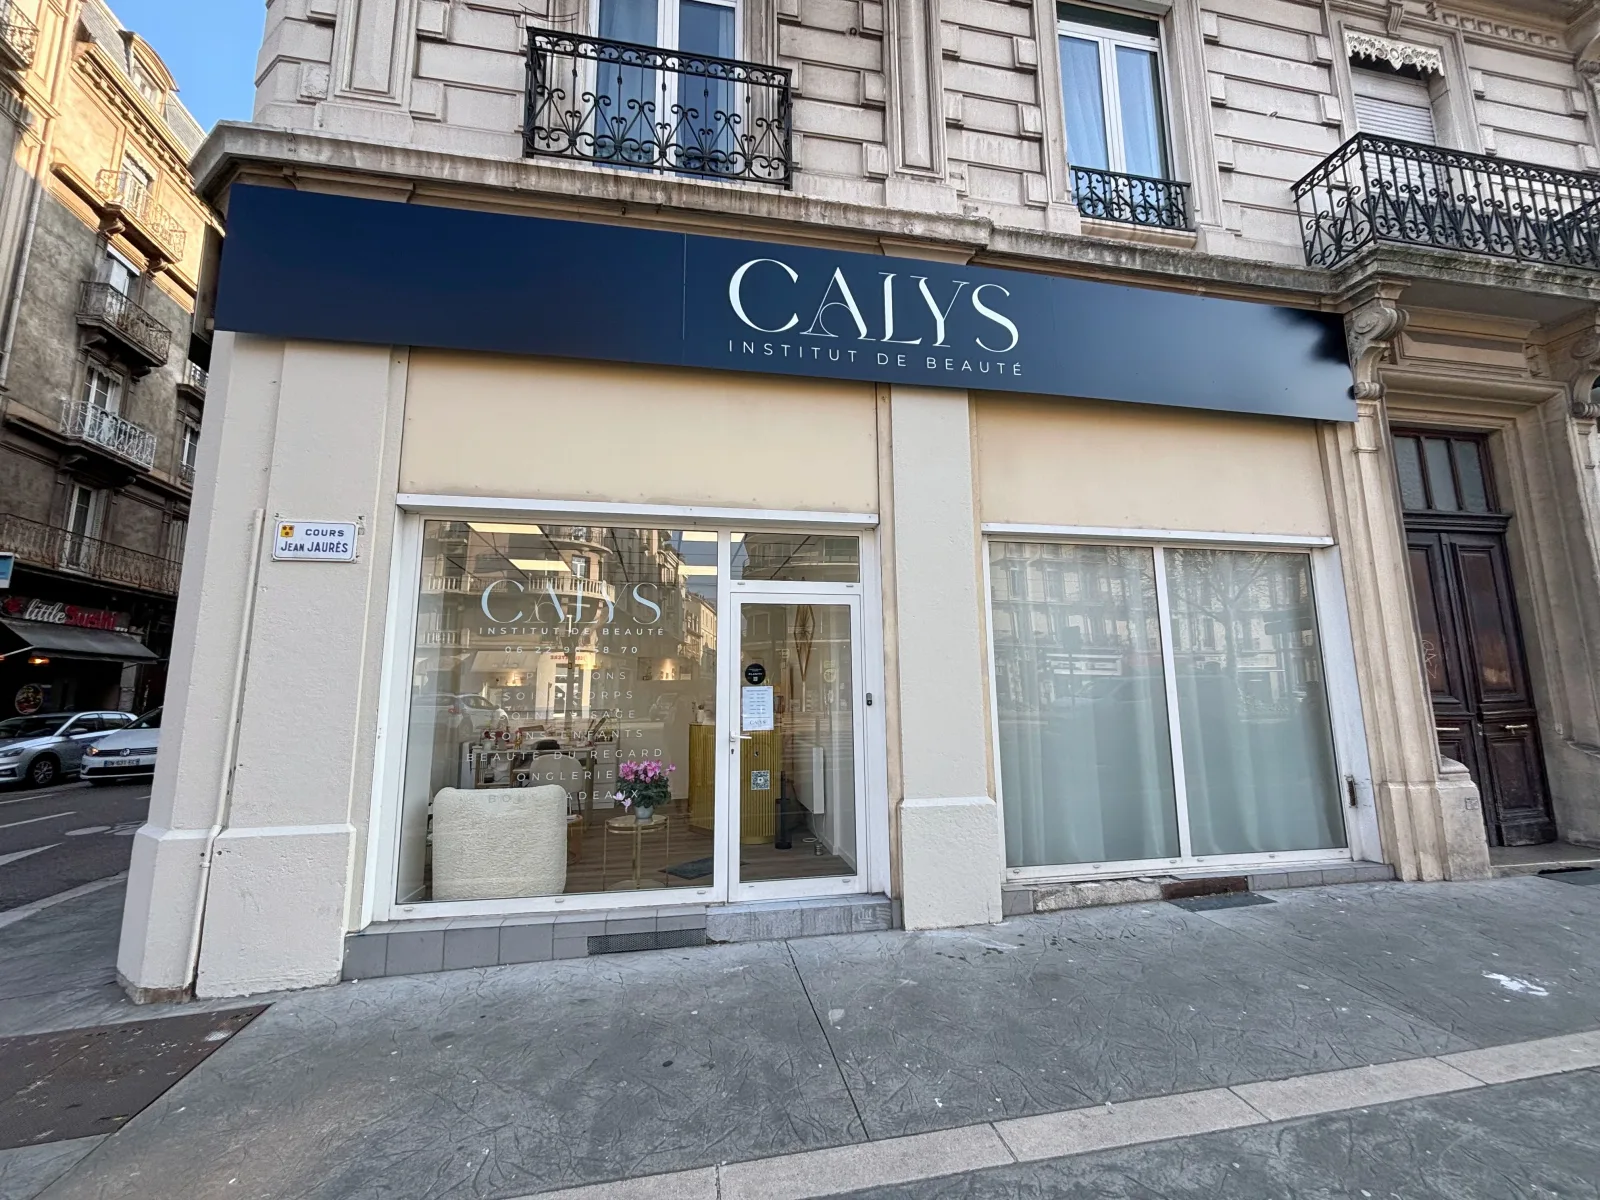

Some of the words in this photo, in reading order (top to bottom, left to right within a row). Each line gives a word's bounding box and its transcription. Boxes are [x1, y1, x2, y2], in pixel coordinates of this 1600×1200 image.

[728, 258, 1019, 353] CALYS
[729, 340, 857, 363] INSTITUT
[877, 352, 907, 367] DE
[926, 356, 1022, 376] BEAUTÉ
[305, 529, 345, 537] COURS
[281, 541, 305, 552] JEAN
[307, 541, 349, 553] JAURÈS
[481, 579, 661, 625] CALYS
[25, 599, 66, 624] little
[479, 627, 560, 635] INSTITUT
[571, 627, 590, 636] DE
[602, 627, 664, 636] BEAUTÉ
[504, 646, 523, 654] 06
[535, 646, 551, 654] 22
[621, 646, 639, 654] 70
[572, 690, 633, 700] CORPS
[569, 710, 636, 720] VSAGE
[490, 732, 547, 741] SOINS
[560, 729, 643, 740] ENFANTS
[554, 750, 576, 760] DU
[590, 749, 662, 759] REGARD
[516, 771, 614, 782] ONGLERIE
[562, 790, 639, 801] ADEAUX
